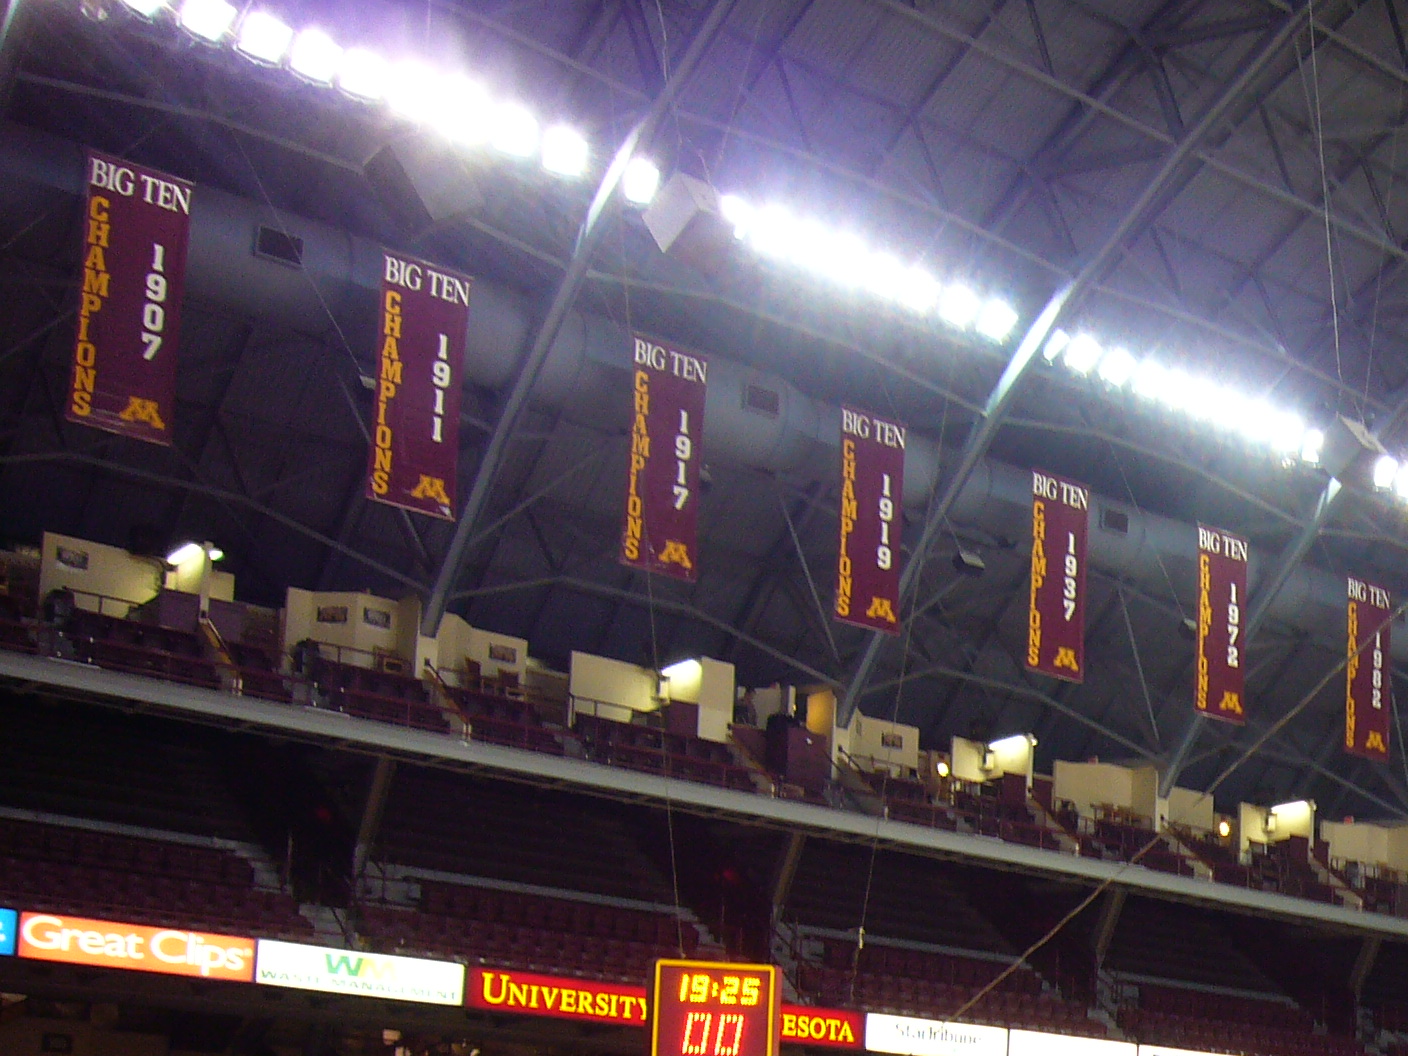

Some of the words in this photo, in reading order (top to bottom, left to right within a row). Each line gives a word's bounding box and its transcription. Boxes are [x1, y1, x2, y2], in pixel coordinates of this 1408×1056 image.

[89, 157, 135, 196] BIG
[141, 174, 192, 215] TEN
[71, 196, 110, 416] CHAMPIONS
[141, 243, 168, 361] 1907
[384, 255, 423, 290] BIG
[427, 270, 470, 307] TEN
[372, 290, 403, 496] CHAMPIONS
[431, 333, 450, 443] 1911
[634, 337, 666, 371] BIG
[670, 351, 707, 384] TEN
[625, 369, 650, 561] CHAMPIONS
[672, 409, 692, 511] 1917
[842, 408, 870, 439] BIG
[873, 418, 906, 450] TEN
[877, 472, 893, 571] 1919
[1032, 471, 1058, 500] BIG
[1060, 481, 1089, 511] TEN
[836, 439, 858, 617] CHAMPIONS
[1198, 527, 1220, 553] BIG
[1222, 536, 1248, 562] TEN
[1028, 500, 1047, 667] CHAMPIONS
[1347, 577, 1367, 603] BIG
[1369, 585, 1391, 610] TEN
[1197, 553, 1212, 710] CHAMPIONS
[22, 915, 144, 959] Great
[481, 971, 647, 1025] UNIVERSITY
[780, 1013, 854, 1043] ESOTA
[679, 973, 761, 1006] 19:25
[681, 1012, 744, 1056] 00
